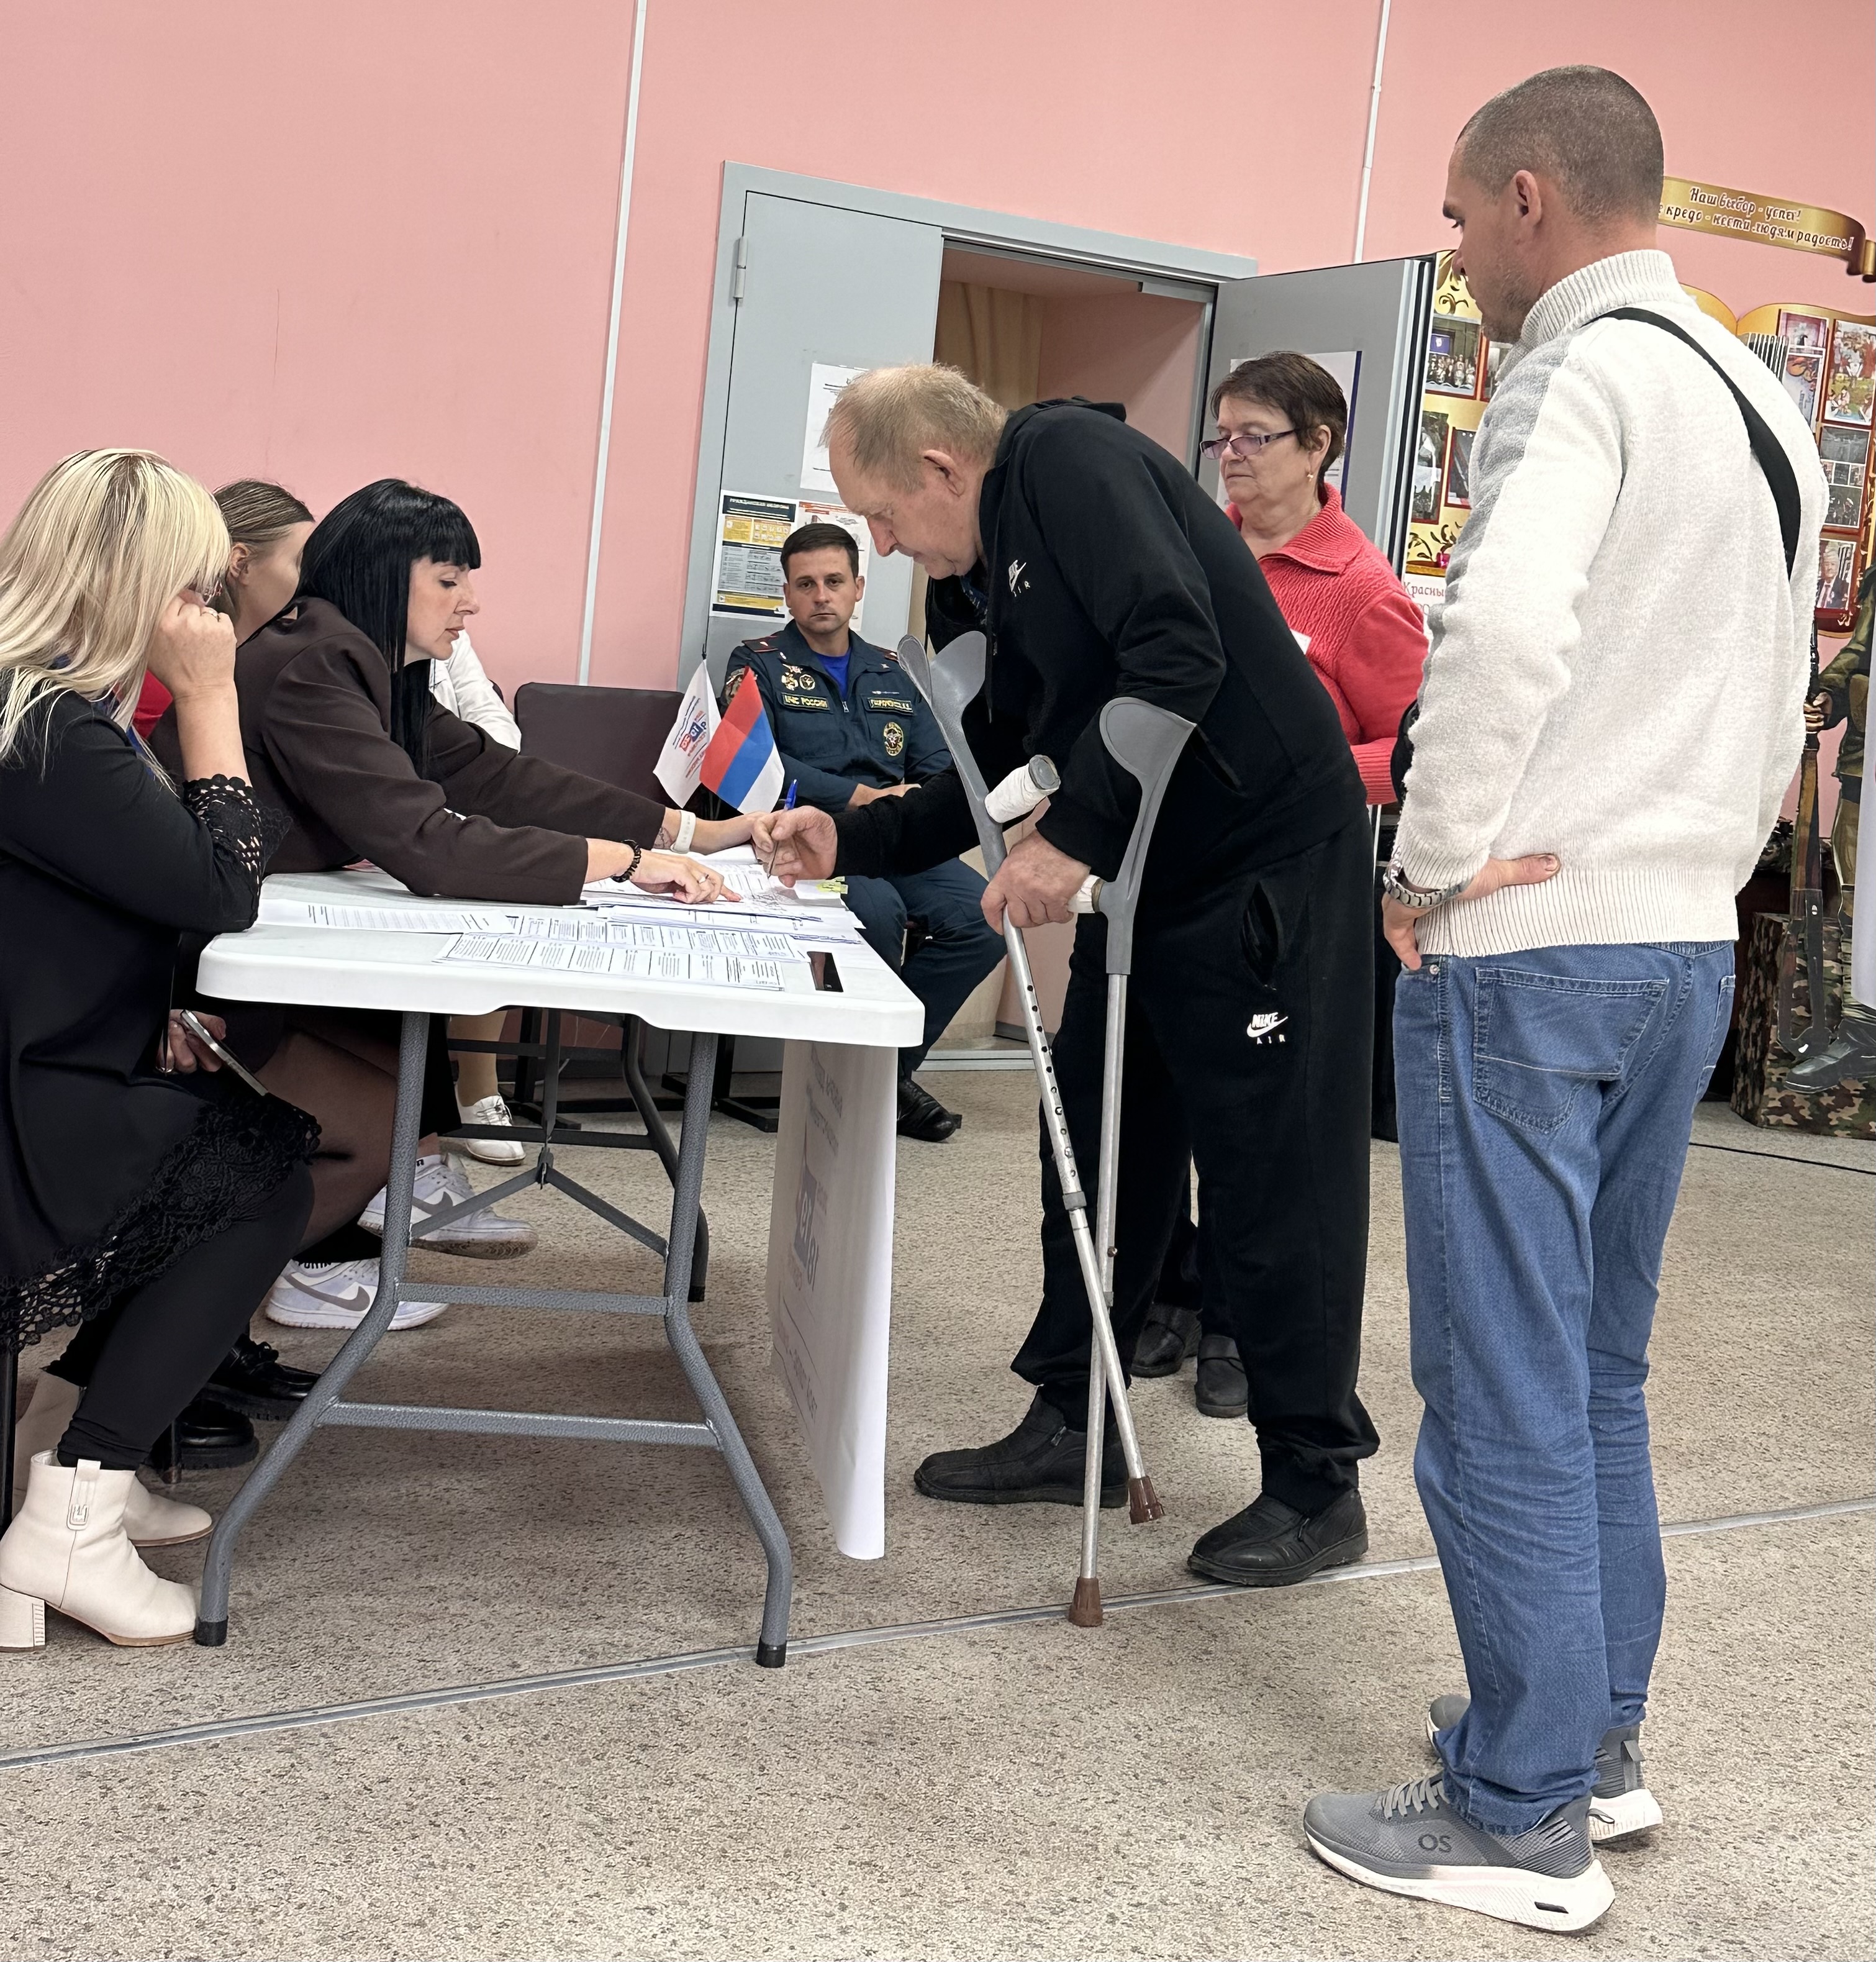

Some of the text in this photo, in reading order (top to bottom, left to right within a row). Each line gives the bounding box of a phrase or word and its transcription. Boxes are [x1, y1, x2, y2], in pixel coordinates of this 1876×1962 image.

[1690, 187, 1718, 206] Наш
[1720, 193, 1756, 216] выбор
[1666, 206, 1703, 223] кредо
[1713, 214, 1751, 230] нести
[1752, 222, 1794, 239] людям
[1797, 230, 1854, 250] радость!
[1251, 1012, 1279, 1028] NIKE
[1257, 1034, 1285, 1045] AIR
[1418, 1833, 1452, 1853] OS
